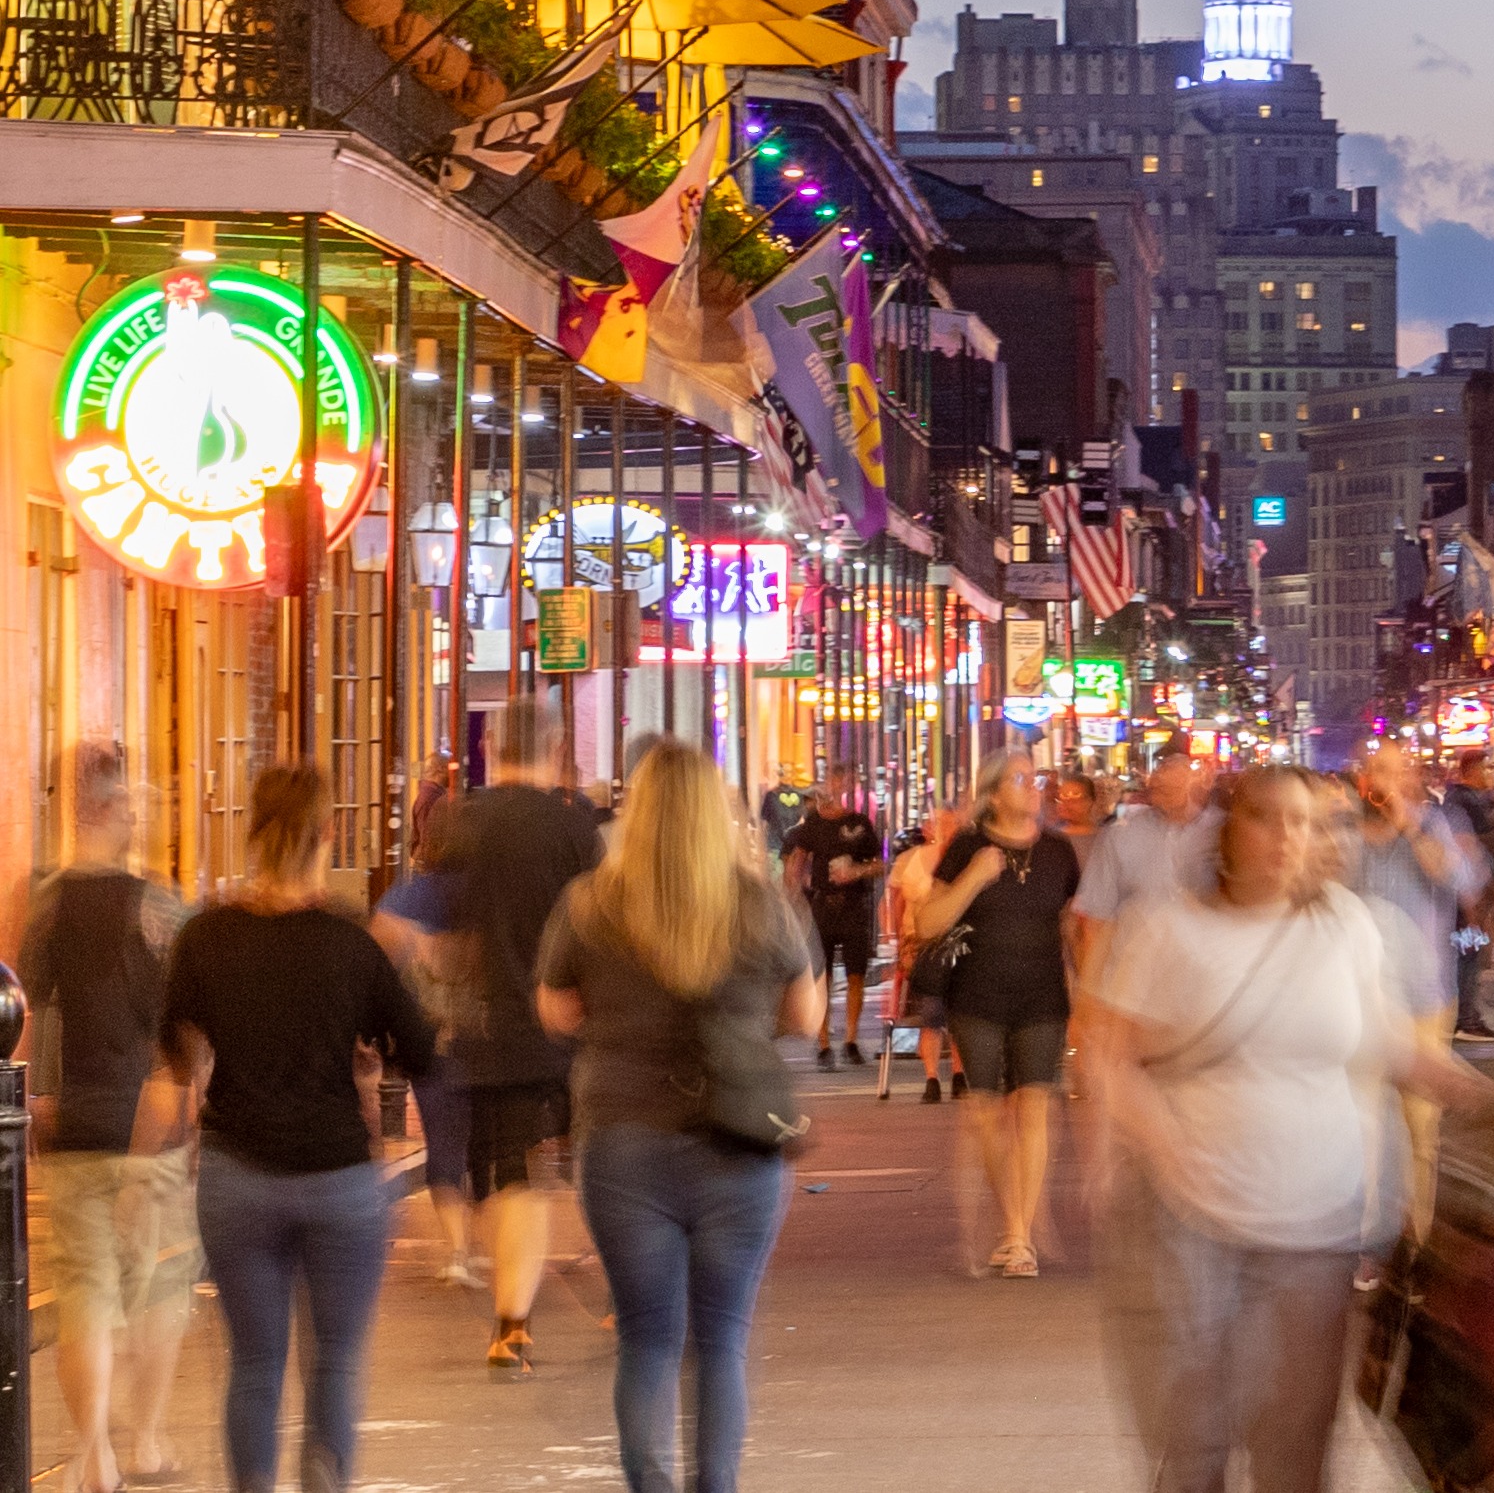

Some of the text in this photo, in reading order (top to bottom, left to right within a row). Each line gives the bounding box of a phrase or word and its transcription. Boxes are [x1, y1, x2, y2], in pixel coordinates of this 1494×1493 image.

[83, 351, 123, 408] LIVE
[113, 308, 165, 356] LIFE
[1257, 501, 1282, 513] AC
